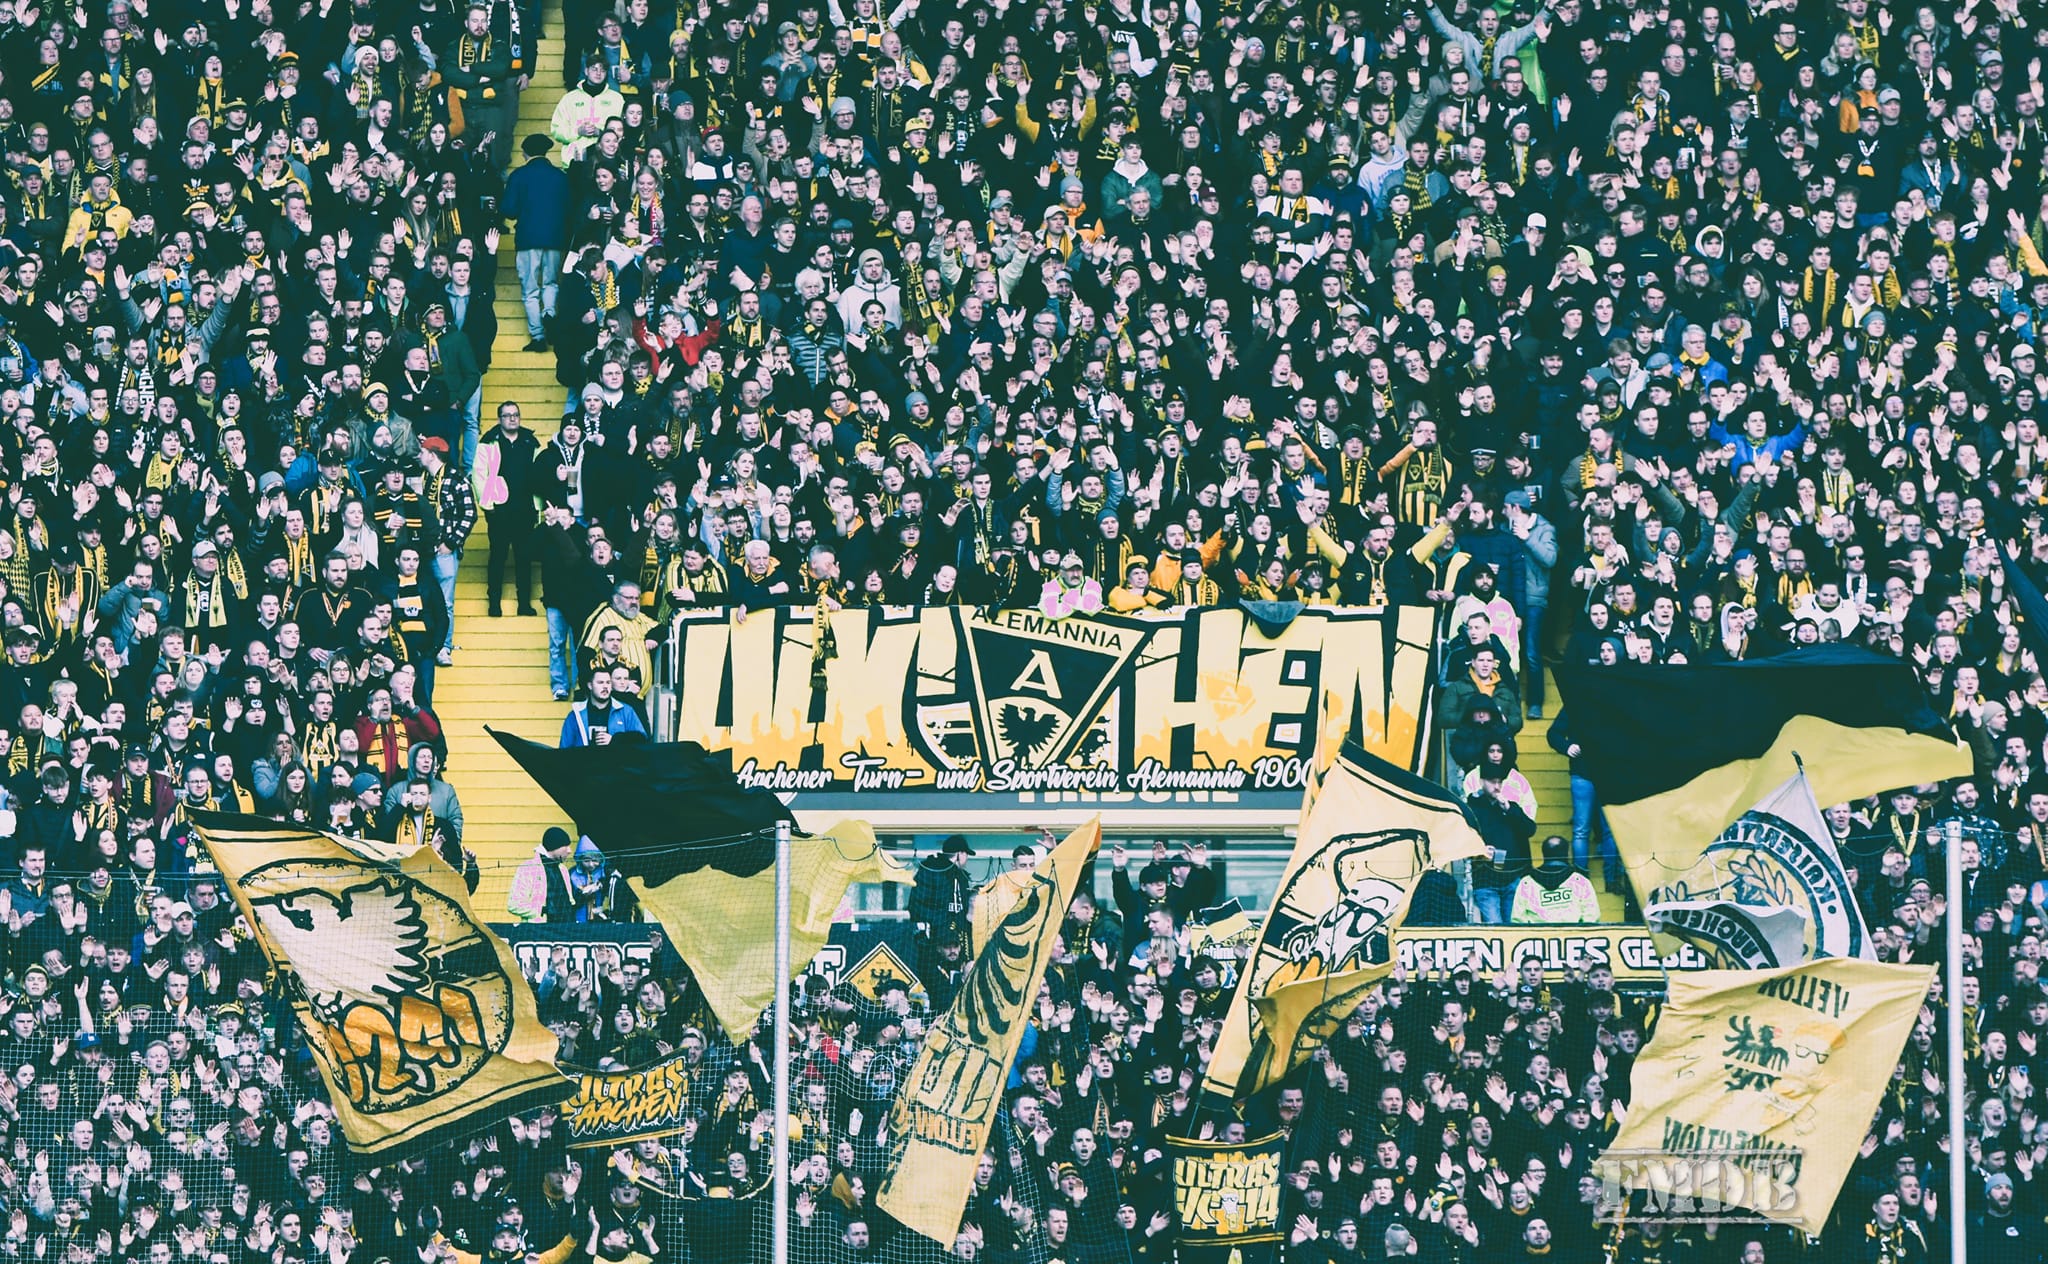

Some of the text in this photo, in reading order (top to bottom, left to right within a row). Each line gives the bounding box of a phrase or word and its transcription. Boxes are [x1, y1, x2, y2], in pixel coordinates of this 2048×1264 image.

[1111, 30, 1136, 43] VAN
[737, 760, 832, 789] Aachener
[841, 754, 923, 792] Turn-
[936, 761, 980, 790] und
[1125, 758, 1246, 790] Alemannia
[1543, 889, 1571, 903] SBG
[1513, 939, 1609, 969] ALLES
[567, 1058, 684, 1107] ULTRAS
[574, 1086, 683, 1132] AACHEN
[1174, 1152, 1281, 1189] ULTRAS
